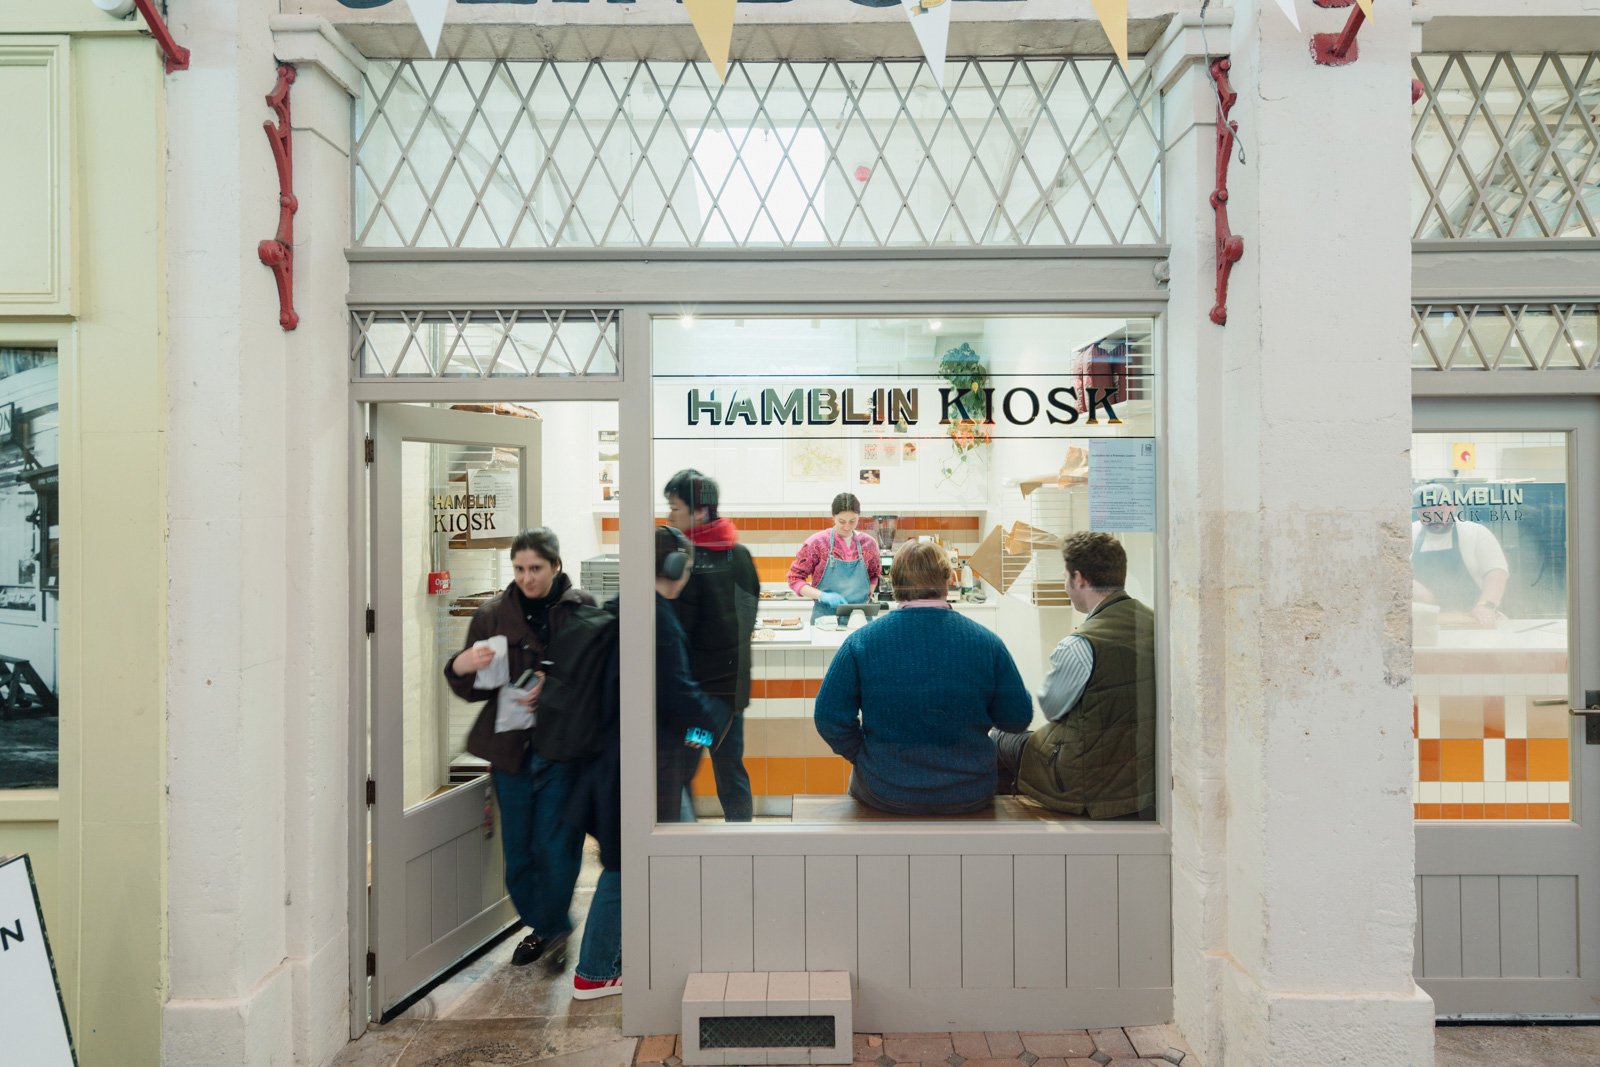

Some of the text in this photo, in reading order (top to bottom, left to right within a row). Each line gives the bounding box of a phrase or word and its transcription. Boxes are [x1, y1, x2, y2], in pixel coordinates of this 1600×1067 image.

[688, 388, 918, 425] HAMBLIN
[938, 387, 1123, 425] KIOSK
[433, 494, 496, 510] HAMBLIN
[1421, 489, 1523, 506] HAMBLIN
[433, 512, 496, 533] KIOSK
[1422, 510, 1524, 523] SNACK BAR
